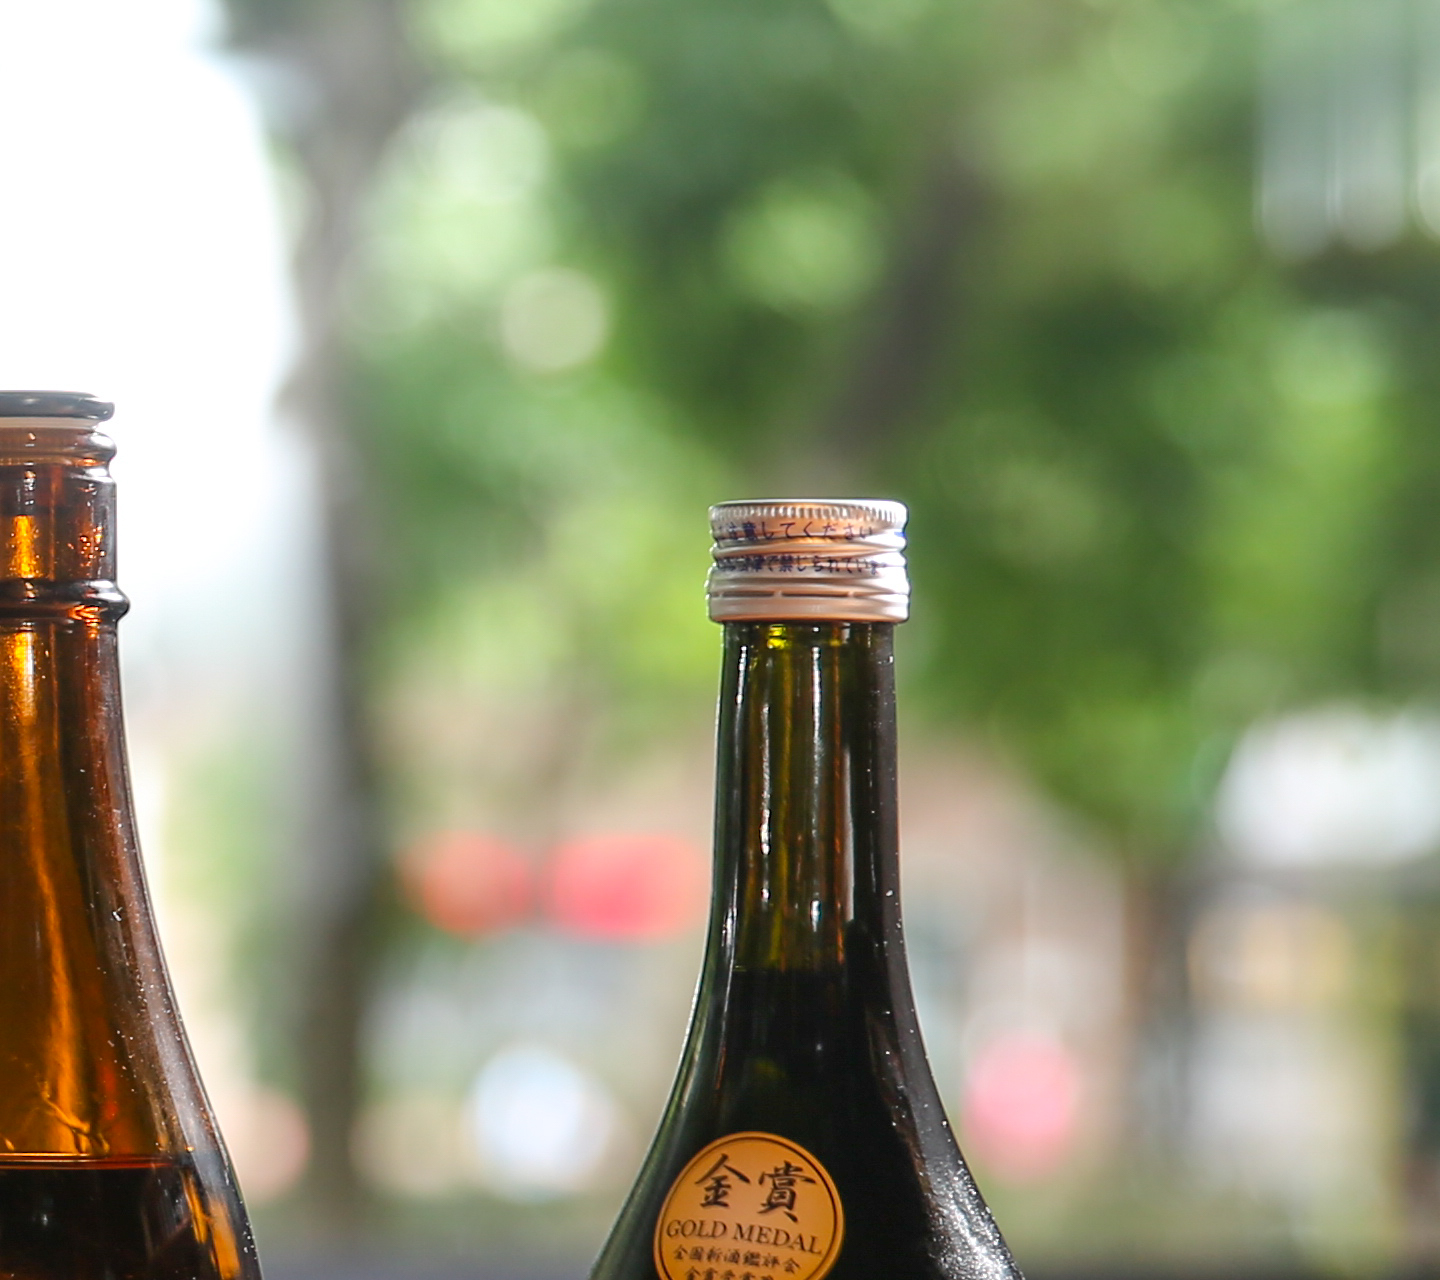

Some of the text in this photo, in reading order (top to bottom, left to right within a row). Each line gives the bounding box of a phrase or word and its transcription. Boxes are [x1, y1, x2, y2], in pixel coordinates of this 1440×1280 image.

[694, 1152, 817, 1224] 金賞
[666, 1219, 823, 1255] GOLD MEDAL
